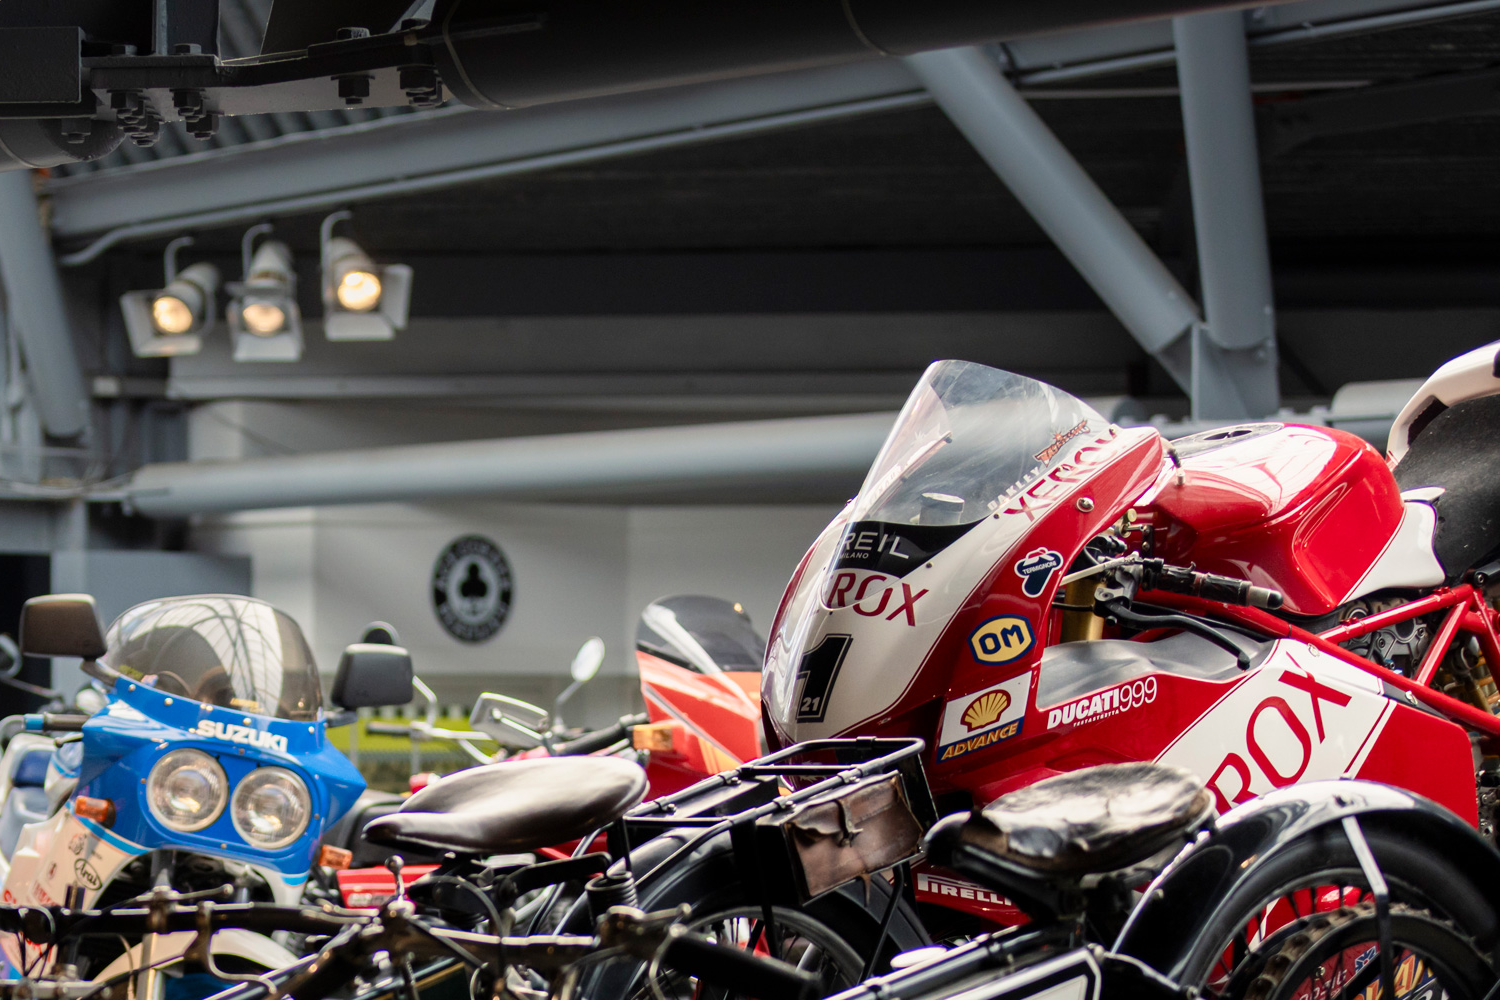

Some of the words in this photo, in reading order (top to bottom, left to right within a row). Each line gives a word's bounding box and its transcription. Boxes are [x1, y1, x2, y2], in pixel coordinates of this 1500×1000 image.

[987, 467, 1041, 511] OAKLEY
[1022, 560, 1057, 575] TERMIGNONI
[979, 624, 1025, 655] OM
[796, 633, 854, 723] 1
[801, 697, 820, 712] 21
[1047, 688, 1119, 730] DUCATI
[1119, 676, 1158, 713] 999
[196, 719, 288, 752] SUZUKI
[941, 721, 1019, 761] ADVANCE
[76, 860, 99, 887] Arai
[917, 873, 1012, 906] PIRELLI
